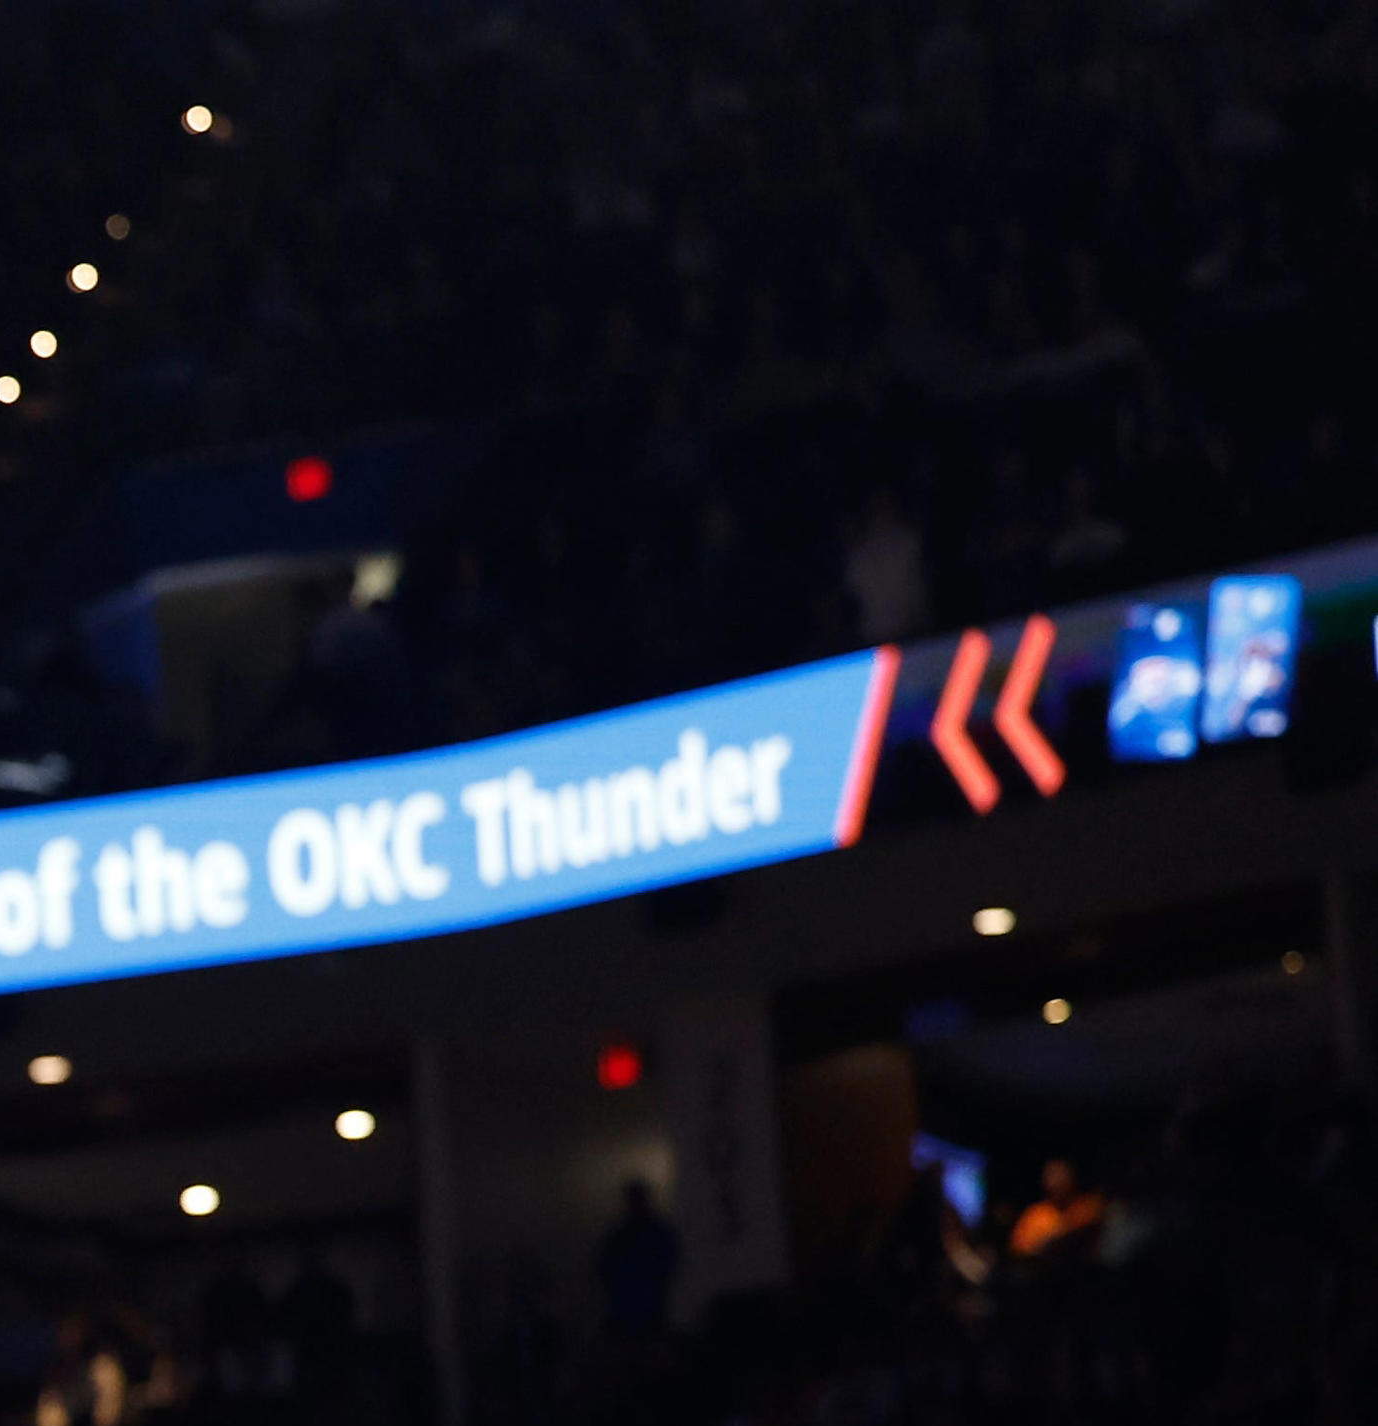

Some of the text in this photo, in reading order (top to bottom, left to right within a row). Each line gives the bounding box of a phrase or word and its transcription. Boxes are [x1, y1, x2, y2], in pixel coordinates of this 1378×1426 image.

[94, 824, 249, 941] the
[267, 791, 449, 917] OKC
[461, 727, 792, 887] Thunder
